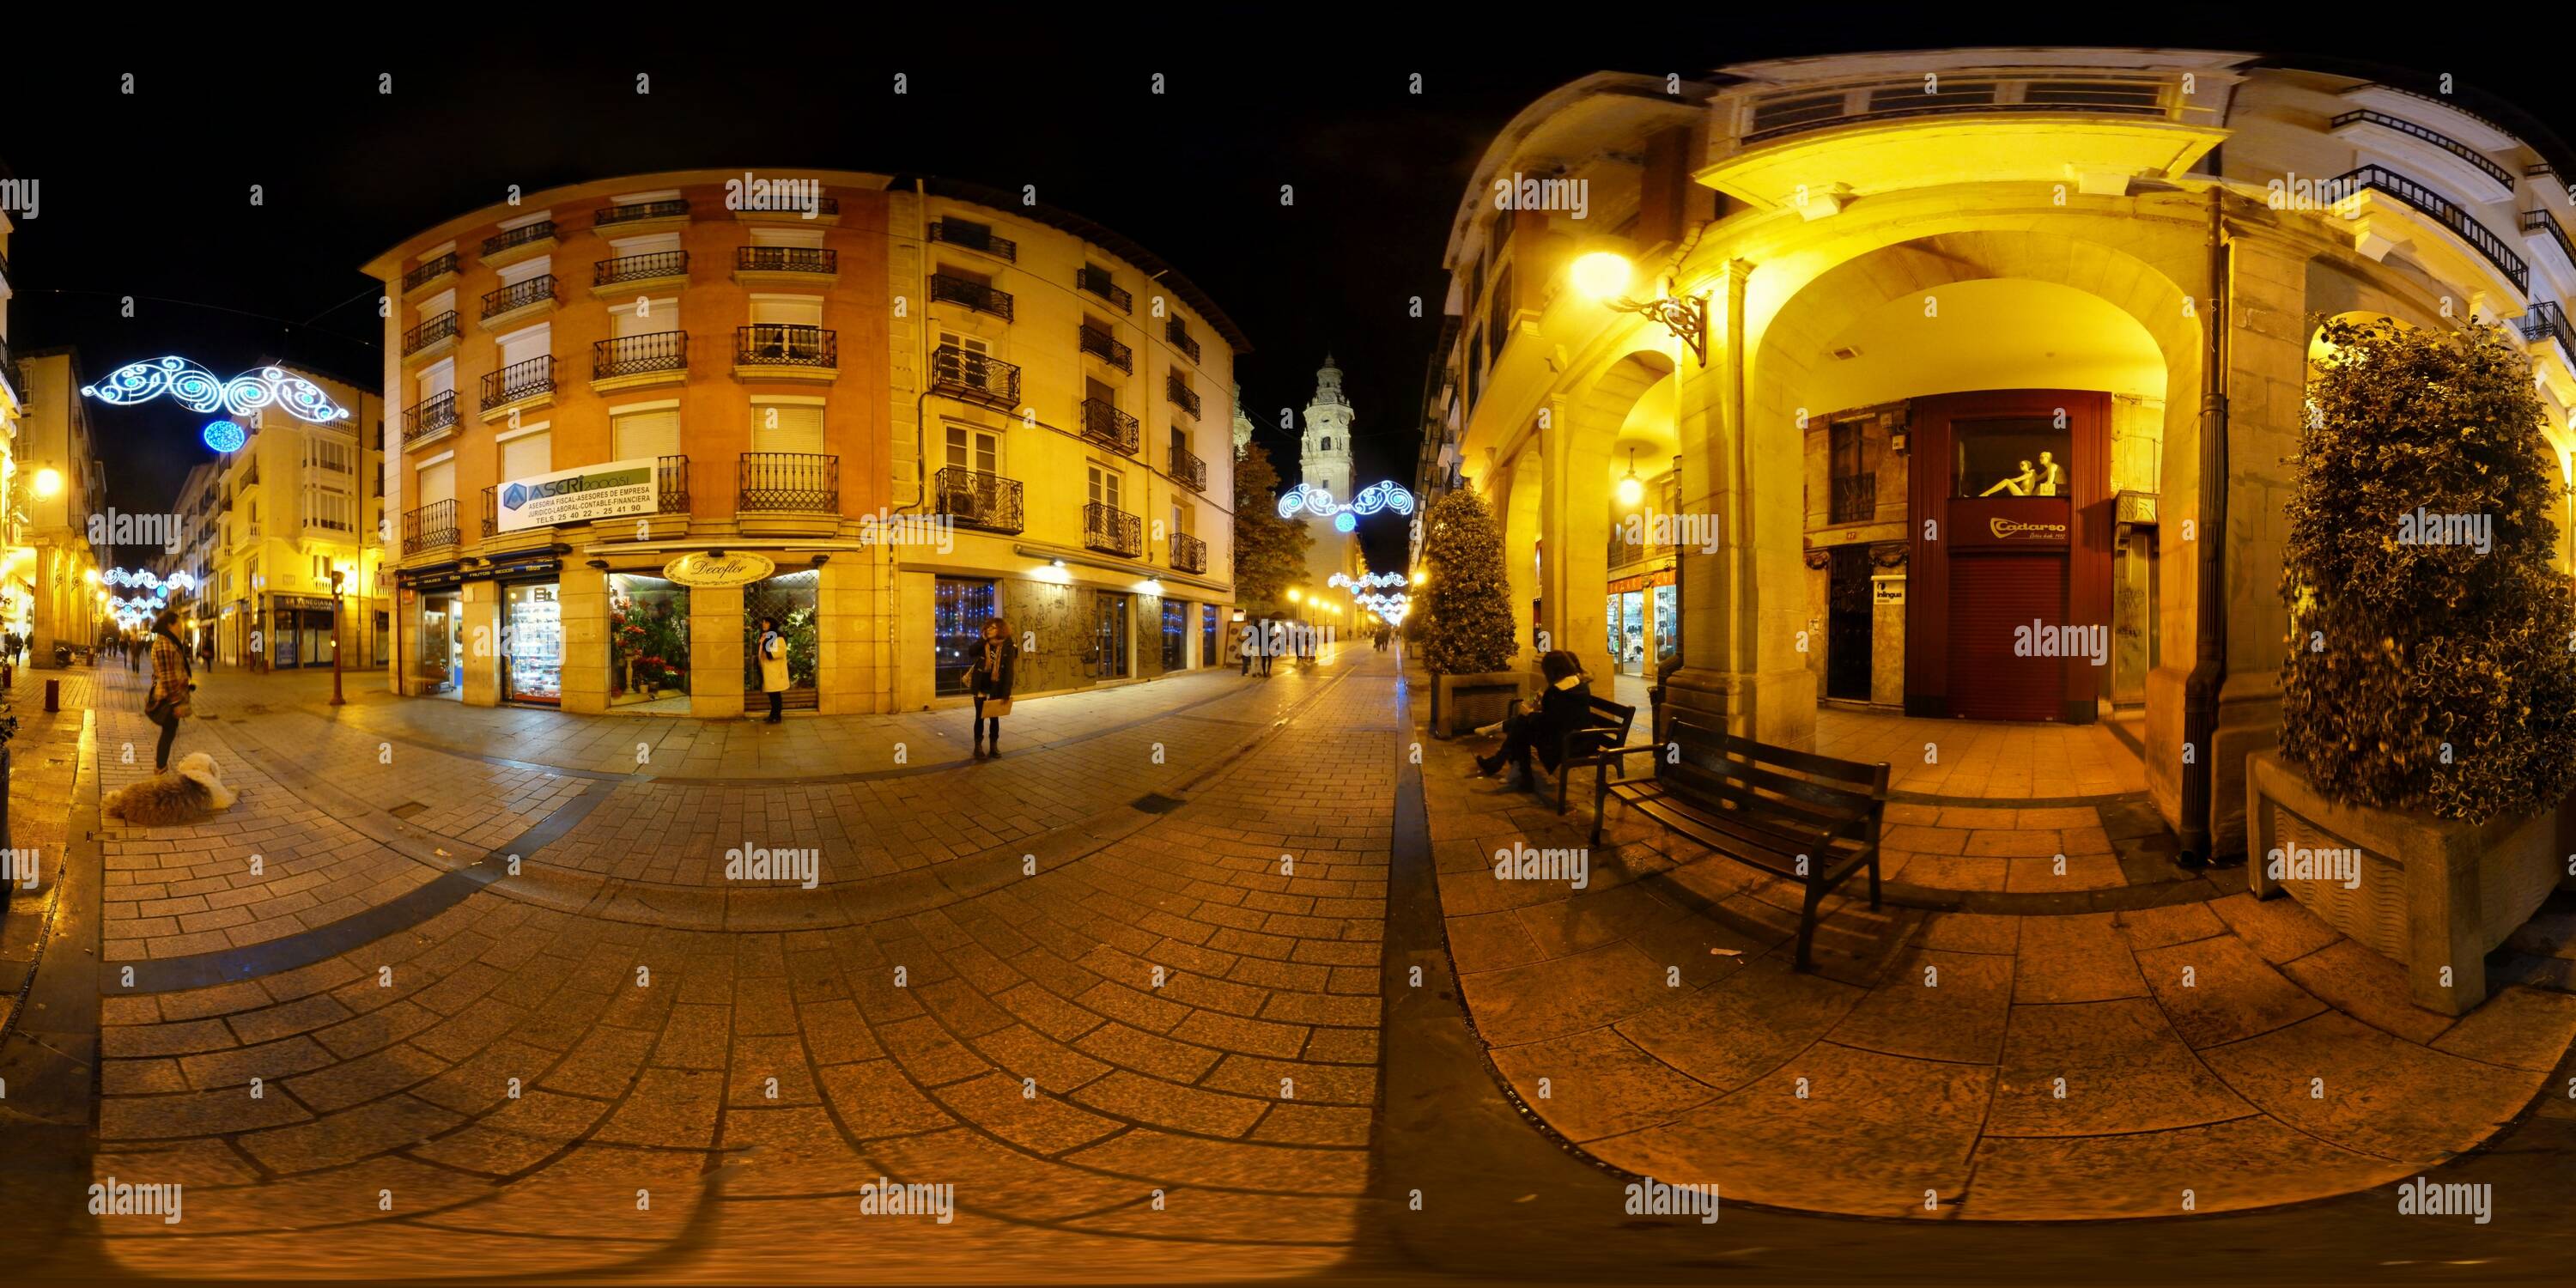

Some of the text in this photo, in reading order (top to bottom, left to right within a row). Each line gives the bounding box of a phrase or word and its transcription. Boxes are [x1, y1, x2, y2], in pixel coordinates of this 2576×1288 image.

[529, 500, 555, 509] ASESORIA
[620, 487, 650, 495] EMPRESA
[1996, 521, 2066, 532] Cadarso
[690, 558, 747, 579] Decoflor
